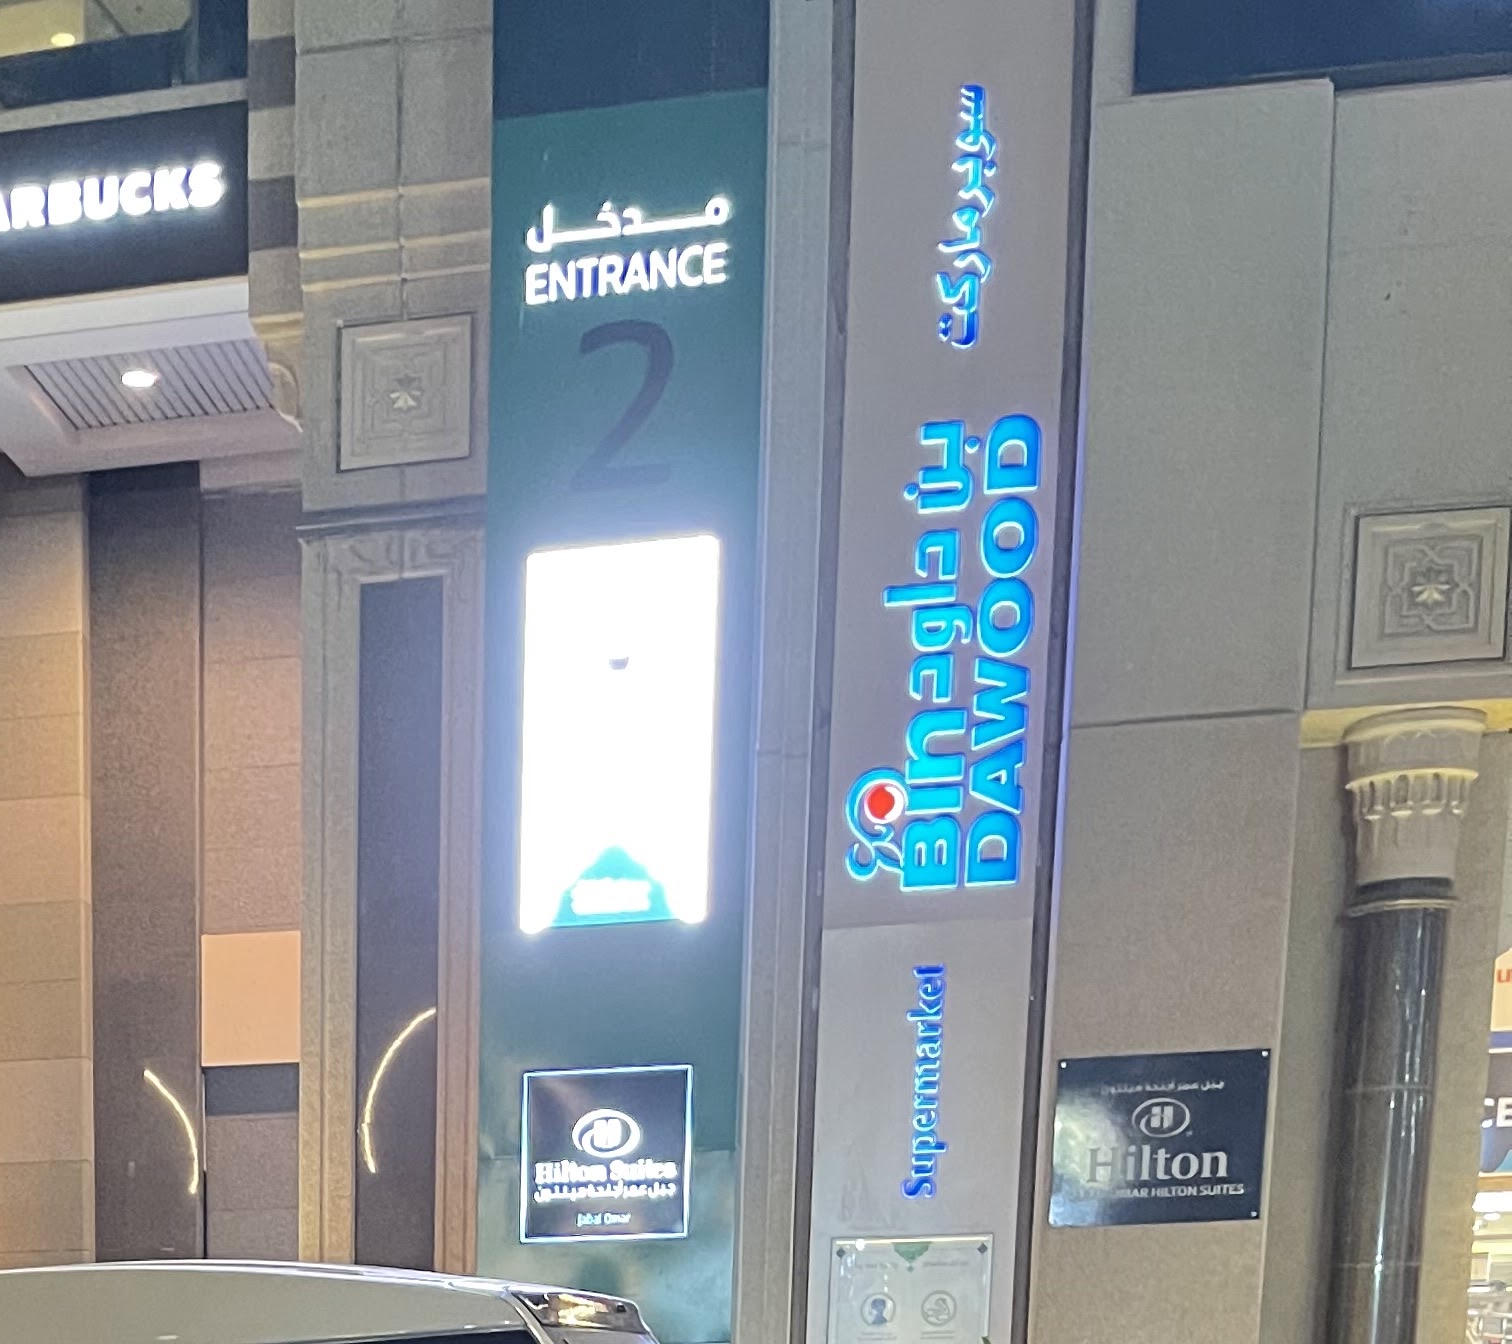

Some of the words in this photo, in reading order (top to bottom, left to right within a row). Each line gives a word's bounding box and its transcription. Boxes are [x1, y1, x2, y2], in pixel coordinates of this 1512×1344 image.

[526, 197, 730, 252] مدخل
[936, 84, 998, 350] سوبرماركت
[525, 242, 730, 306] ENTRANCE
[571, 319, 674, 492] 2
[964, 413, 1042, 887] DAWOOD
[901, 963, 949, 1200] Supermarket
[534, 1160, 608, 1184] Hilton
[609, 1159, 678, 1181] Suites
[1087, 1144, 1228, 1184] Hilton
[1150, 1184, 1198, 1198] HILTON
[1199, 1183, 1245, 1196] SUITES
